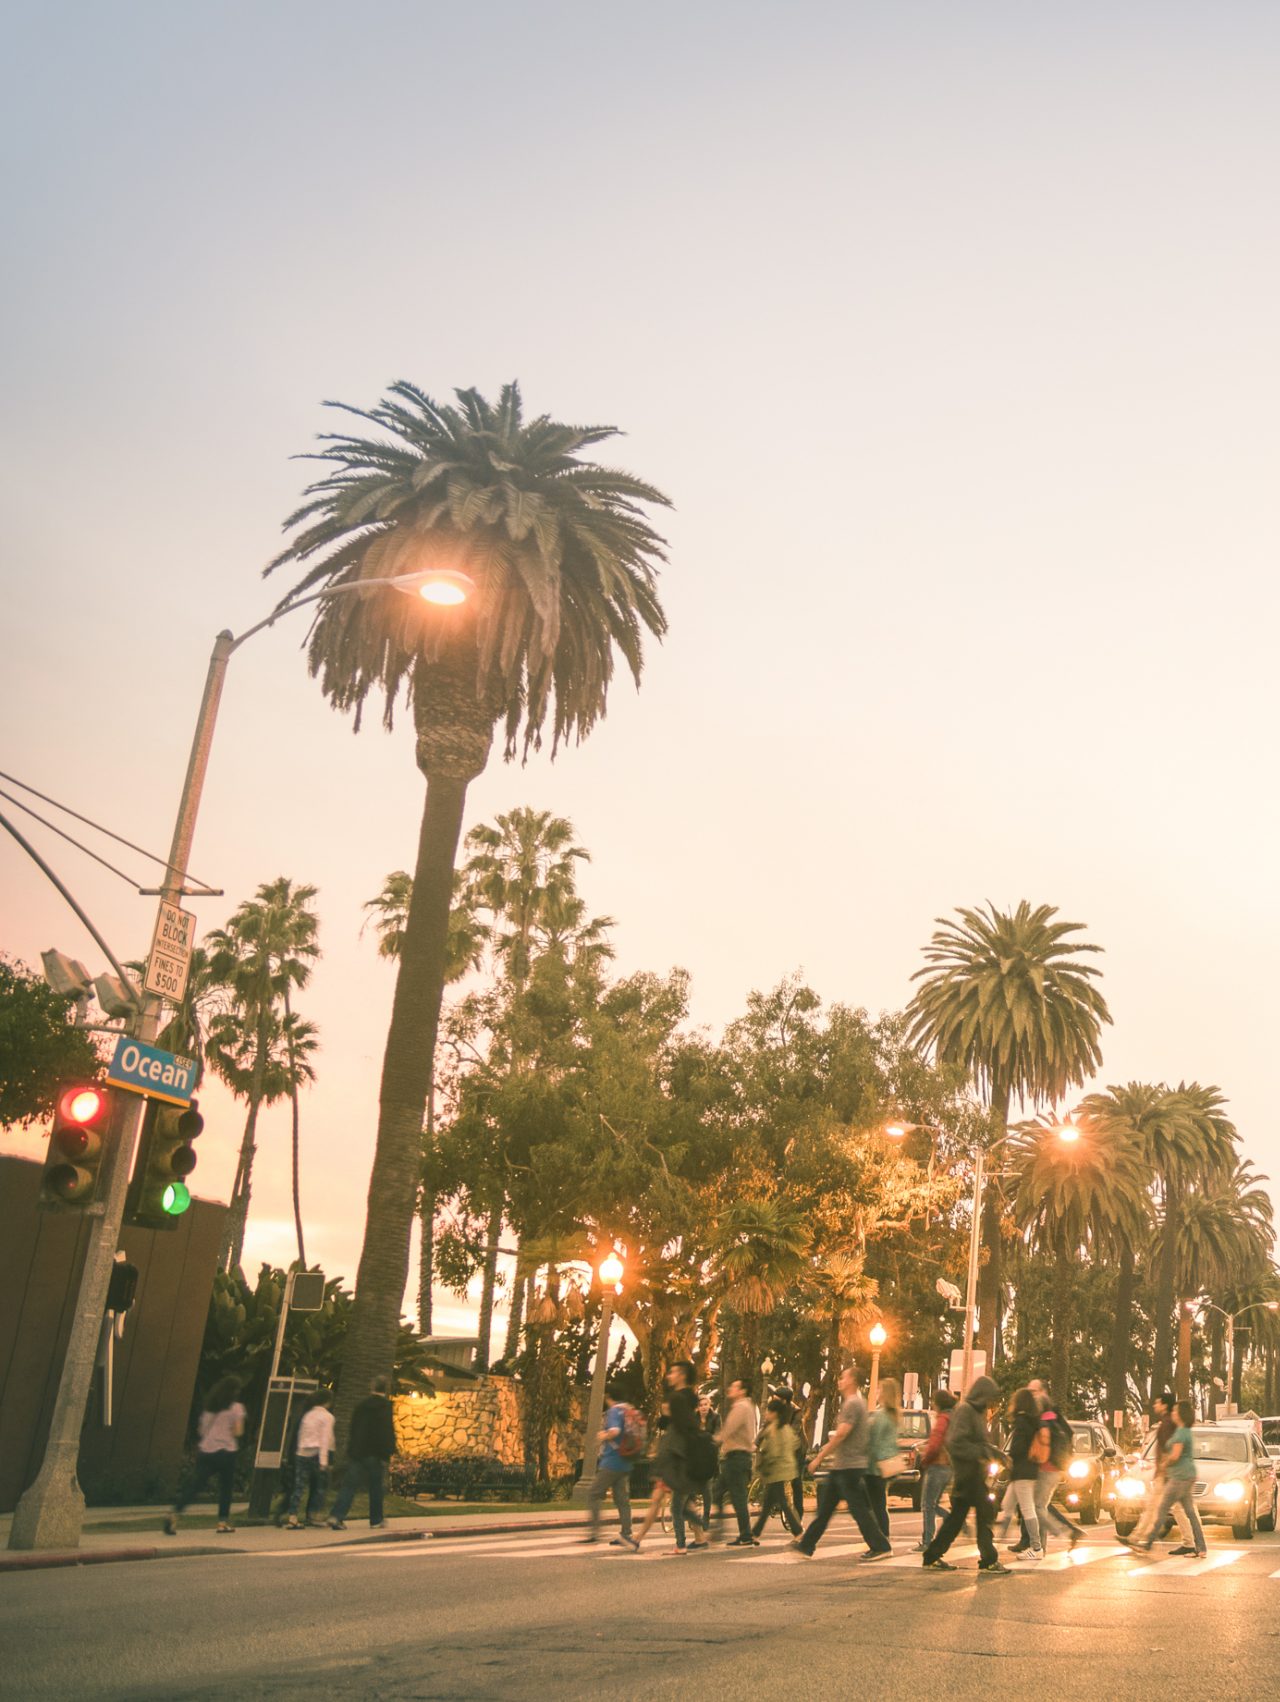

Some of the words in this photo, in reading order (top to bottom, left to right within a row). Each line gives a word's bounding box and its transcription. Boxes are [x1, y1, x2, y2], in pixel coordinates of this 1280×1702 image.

[166, 910, 176, 923] DO
[178, 915, 189, 929] NOT
[162, 923, 188, 946] BLOCK
[154, 956, 175, 974] FINES
[176, 966, 184, 978] TO
[155, 973, 178, 993] $500
[121, 1046, 189, 1090] Ocean
